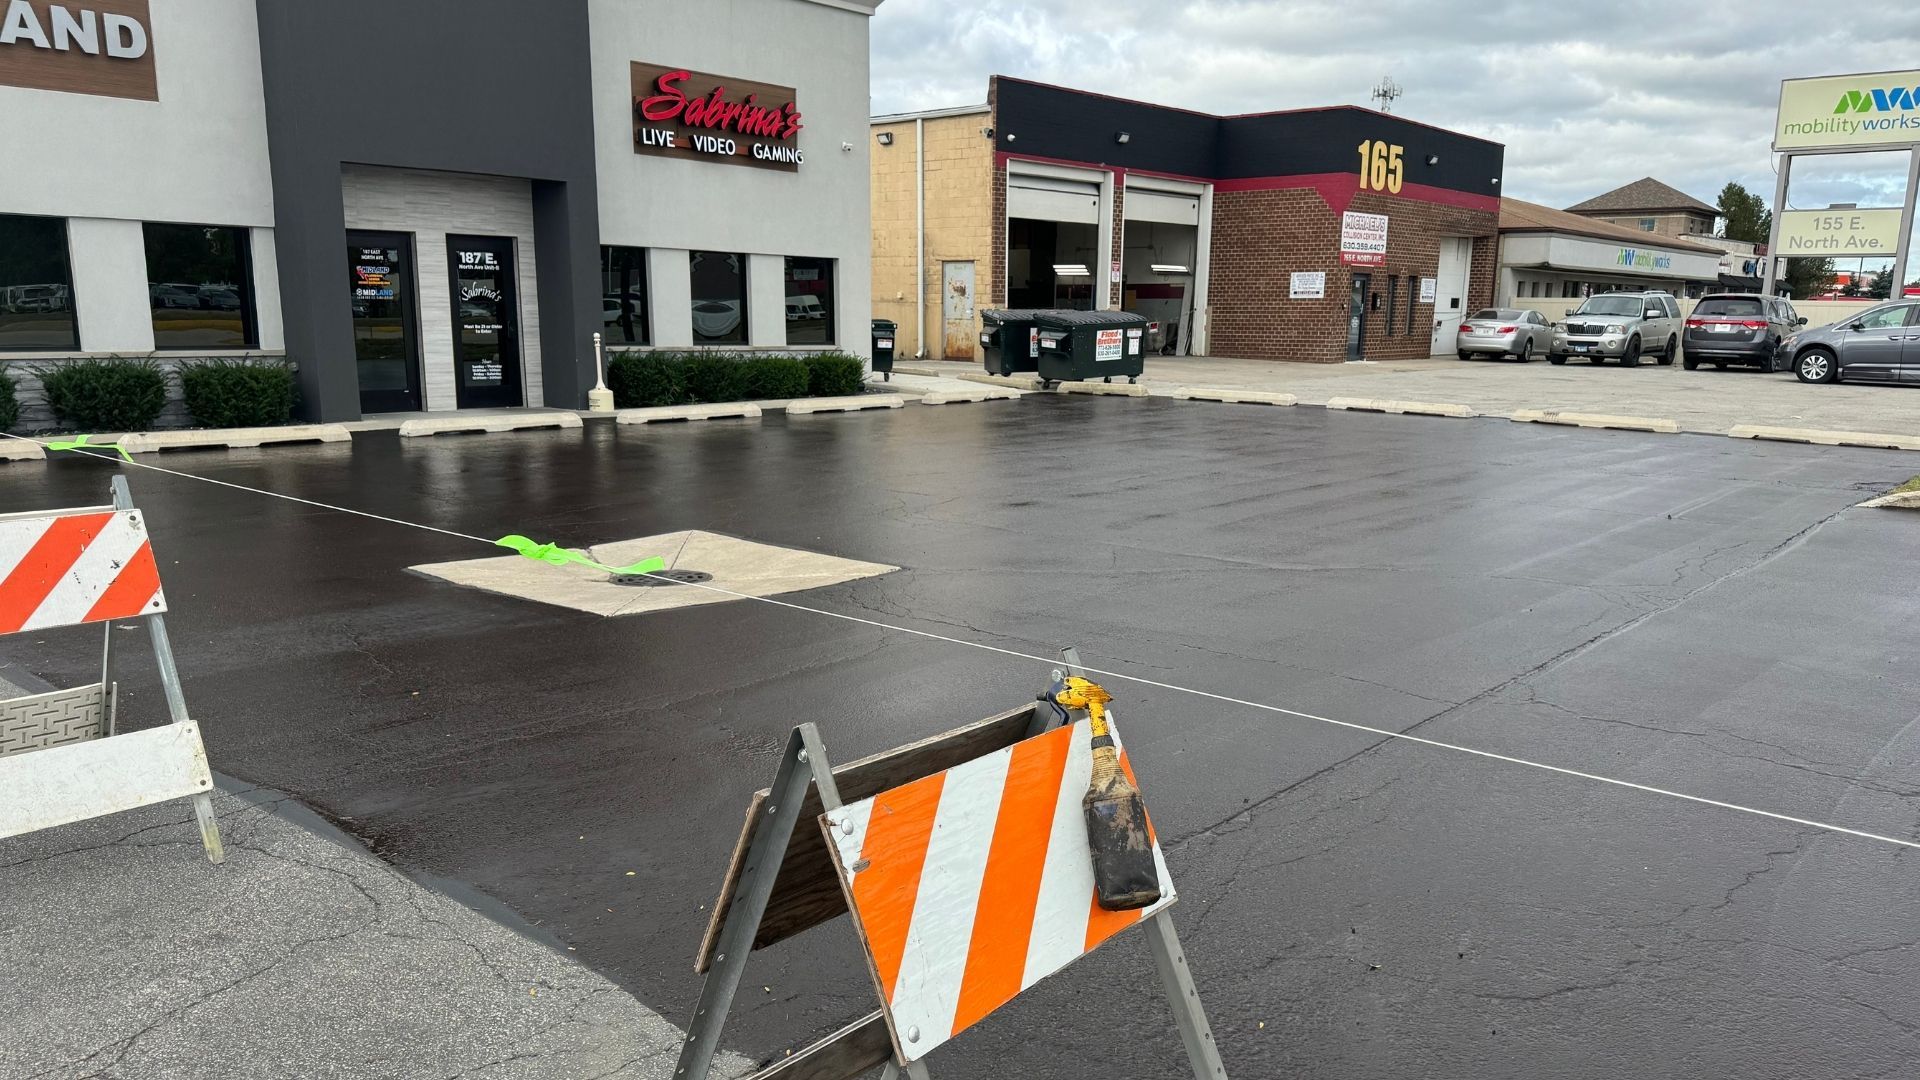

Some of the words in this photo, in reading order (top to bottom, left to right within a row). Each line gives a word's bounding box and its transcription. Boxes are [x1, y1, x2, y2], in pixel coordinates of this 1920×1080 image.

[0, 0, 147, 59] AND
[642, 70, 803, 140] Sabrina's
[642, 128, 676, 148] LIVE
[693, 134, 736, 156] VIDEO
[753, 143, 804, 164] GAMING
[1358, 139, 1404, 194] 165
[1344, 214, 1386, 232] MICHAEL'S
[1813, 216, 1843, 232] 155
[1849, 216, 1865, 230] E.
[1343, 231, 1362, 240] COLLISION
[1789, 235, 1839, 249] North
[1845, 234, 1884, 248] Ave.
[459, 251, 481, 264] 187
[485, 252, 497, 265] E.
[1357, 255, 1372, 263] NORTH
[461, 281, 502, 302] Sabrina's
